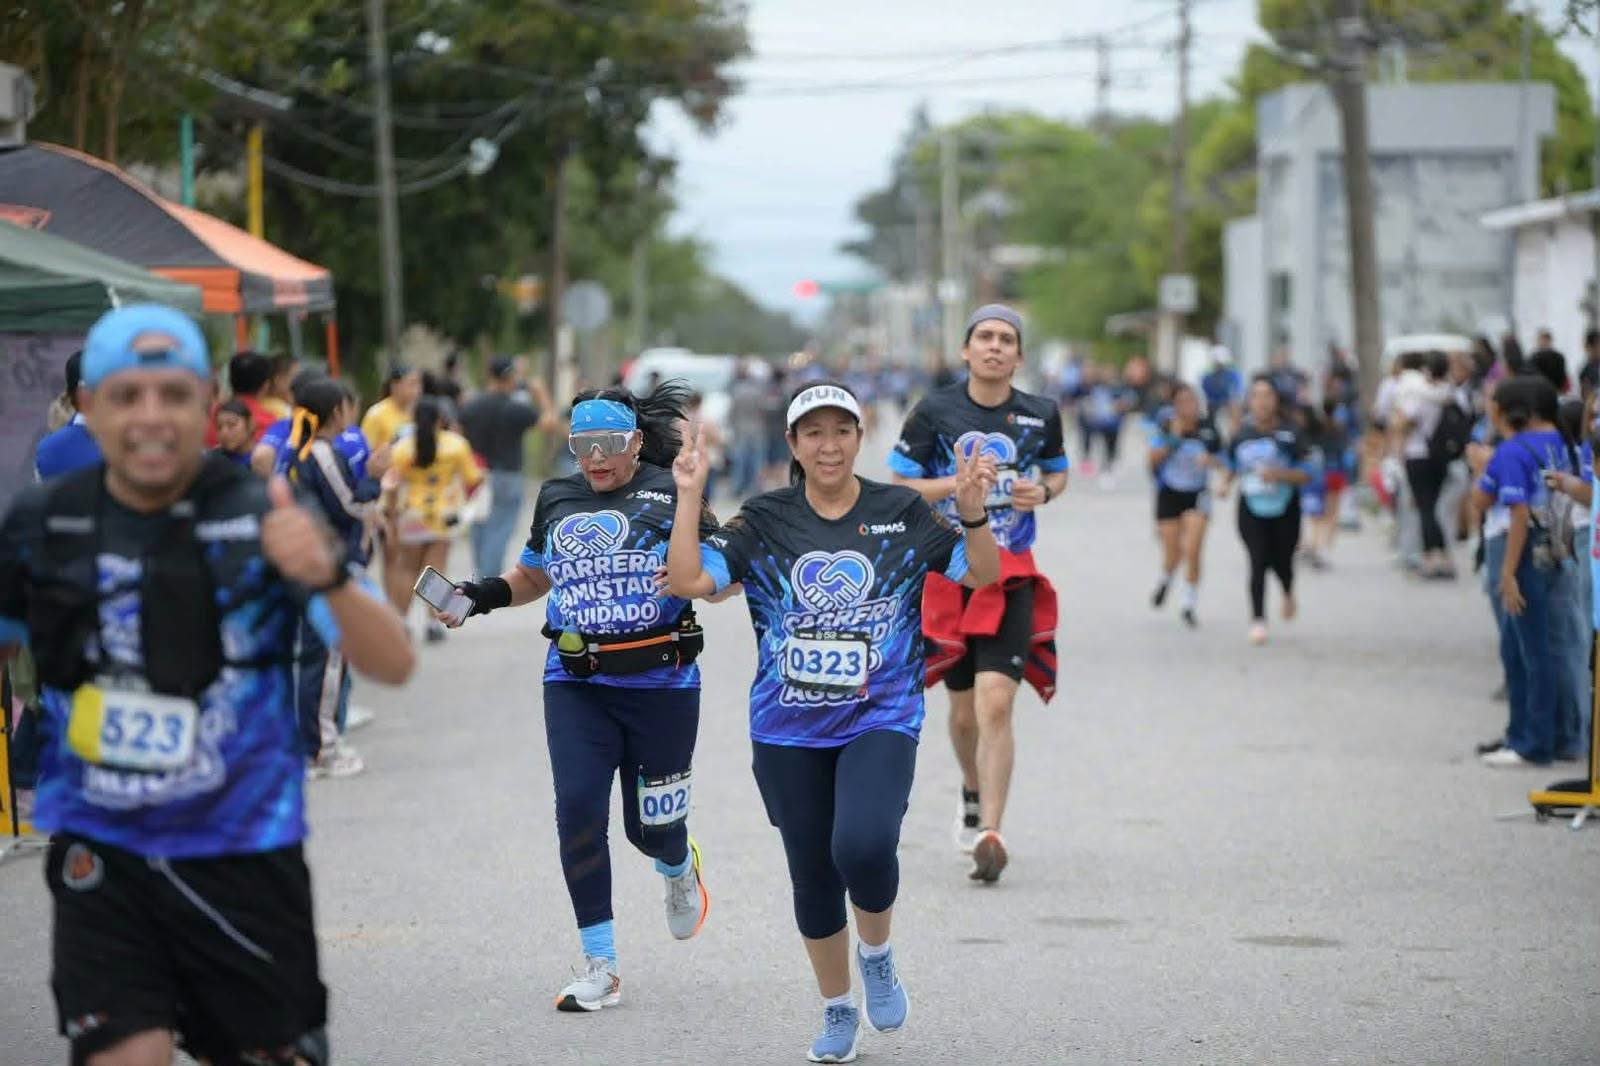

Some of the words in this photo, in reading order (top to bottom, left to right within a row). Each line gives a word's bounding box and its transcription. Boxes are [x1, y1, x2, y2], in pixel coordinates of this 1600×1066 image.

[799, 387, 845, 405] RUN
[636, 490, 672, 504] SIMAS
[871, 521, 907, 535] SIMAS
[549, 554, 658, 585] CARRERA
[560, 575, 656, 608] AMISTAD
[790, 647, 861, 677] 0323
[101, 705, 184, 752] 523
[643, 785, 691, 817] 002
